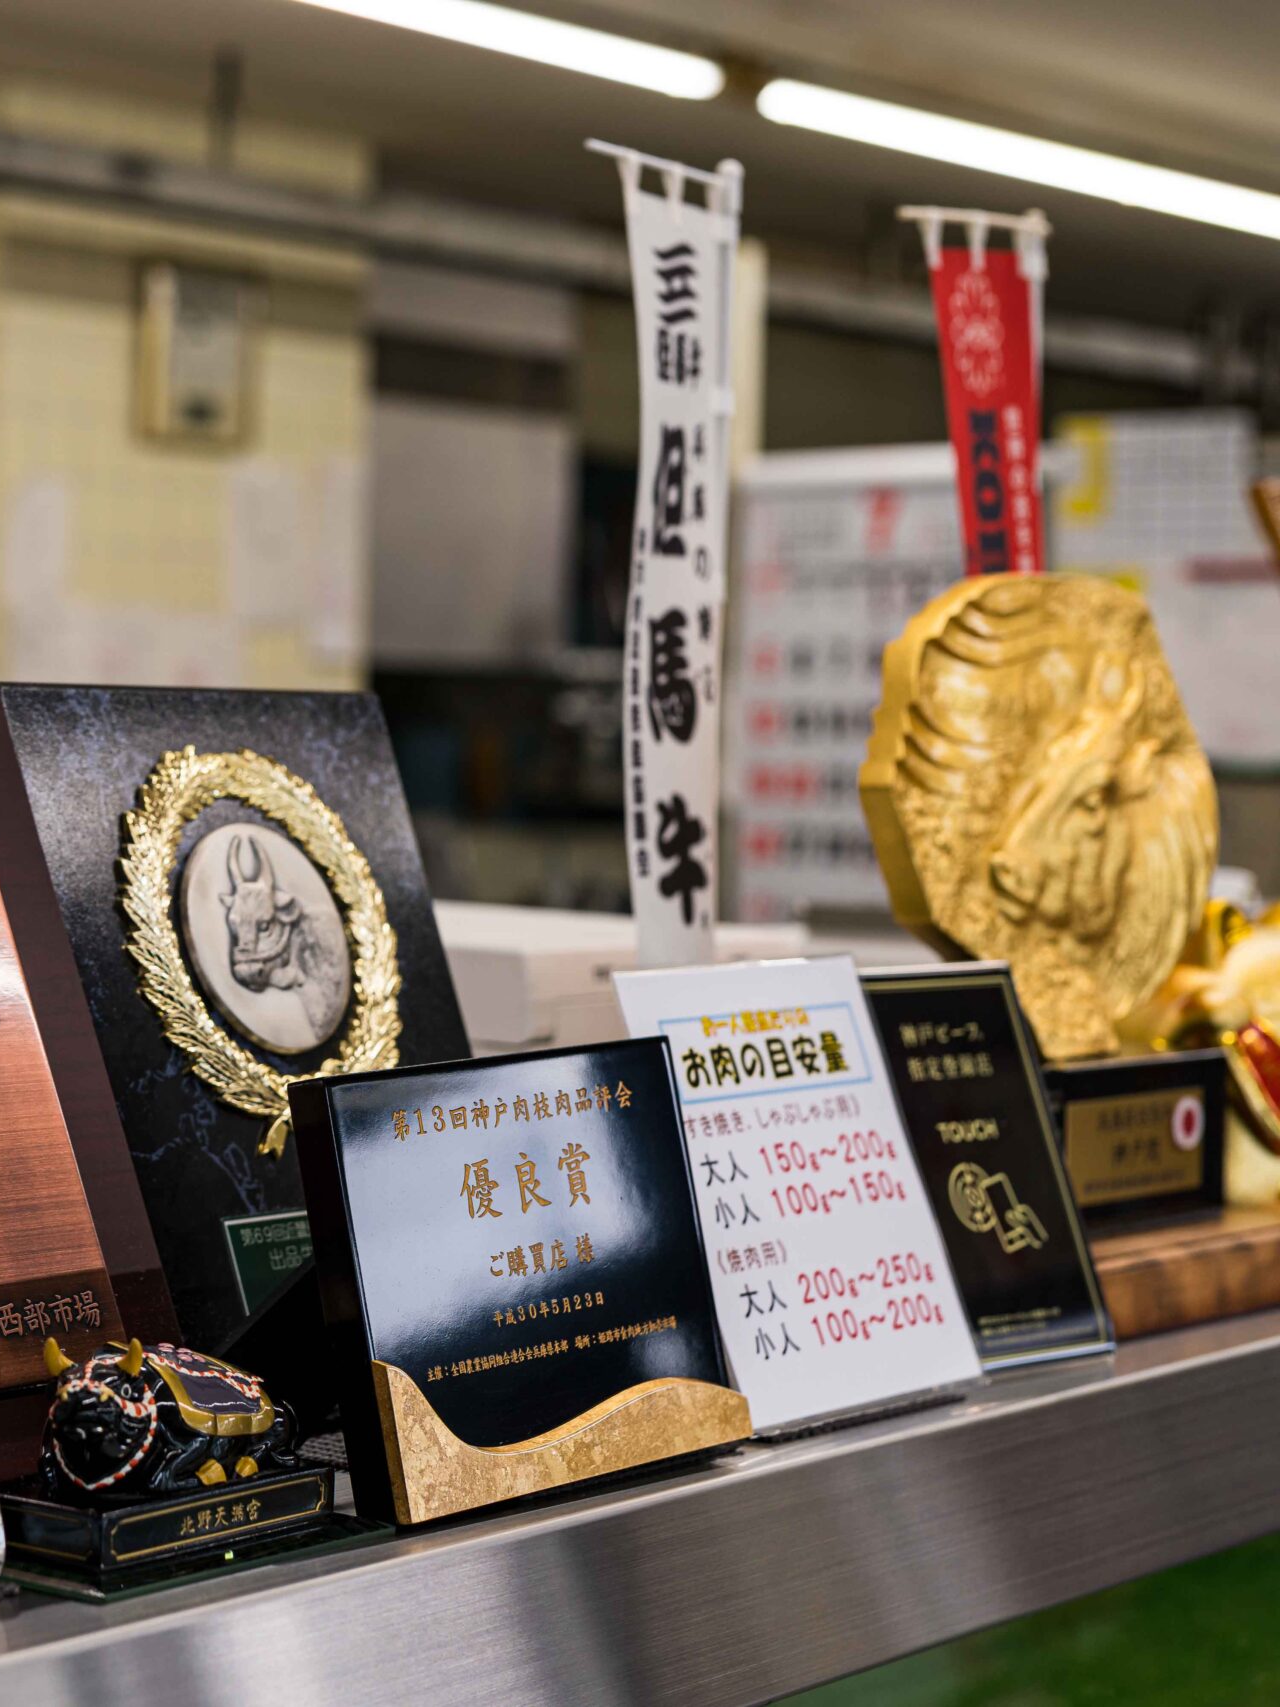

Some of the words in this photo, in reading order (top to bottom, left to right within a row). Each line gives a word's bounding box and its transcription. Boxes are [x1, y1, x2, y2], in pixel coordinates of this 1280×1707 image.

[681, 1031, 849, 1090] お肉の目安量
[391, 1080, 634, 1142] 第13回神戸肉枝肉品評会
[935, 1118, 1000, 1144] TOUCH
[460, 1142, 593, 1220] 優良賞
[699, 1150, 748, 1187] 大人
[714, 1194, 761, 1230] 小人
[492, 1291, 606, 1327] 平成30年5月23日
[739, 1279, 787, 1319] 大人
[754, 1323, 801, 1361] 小人
